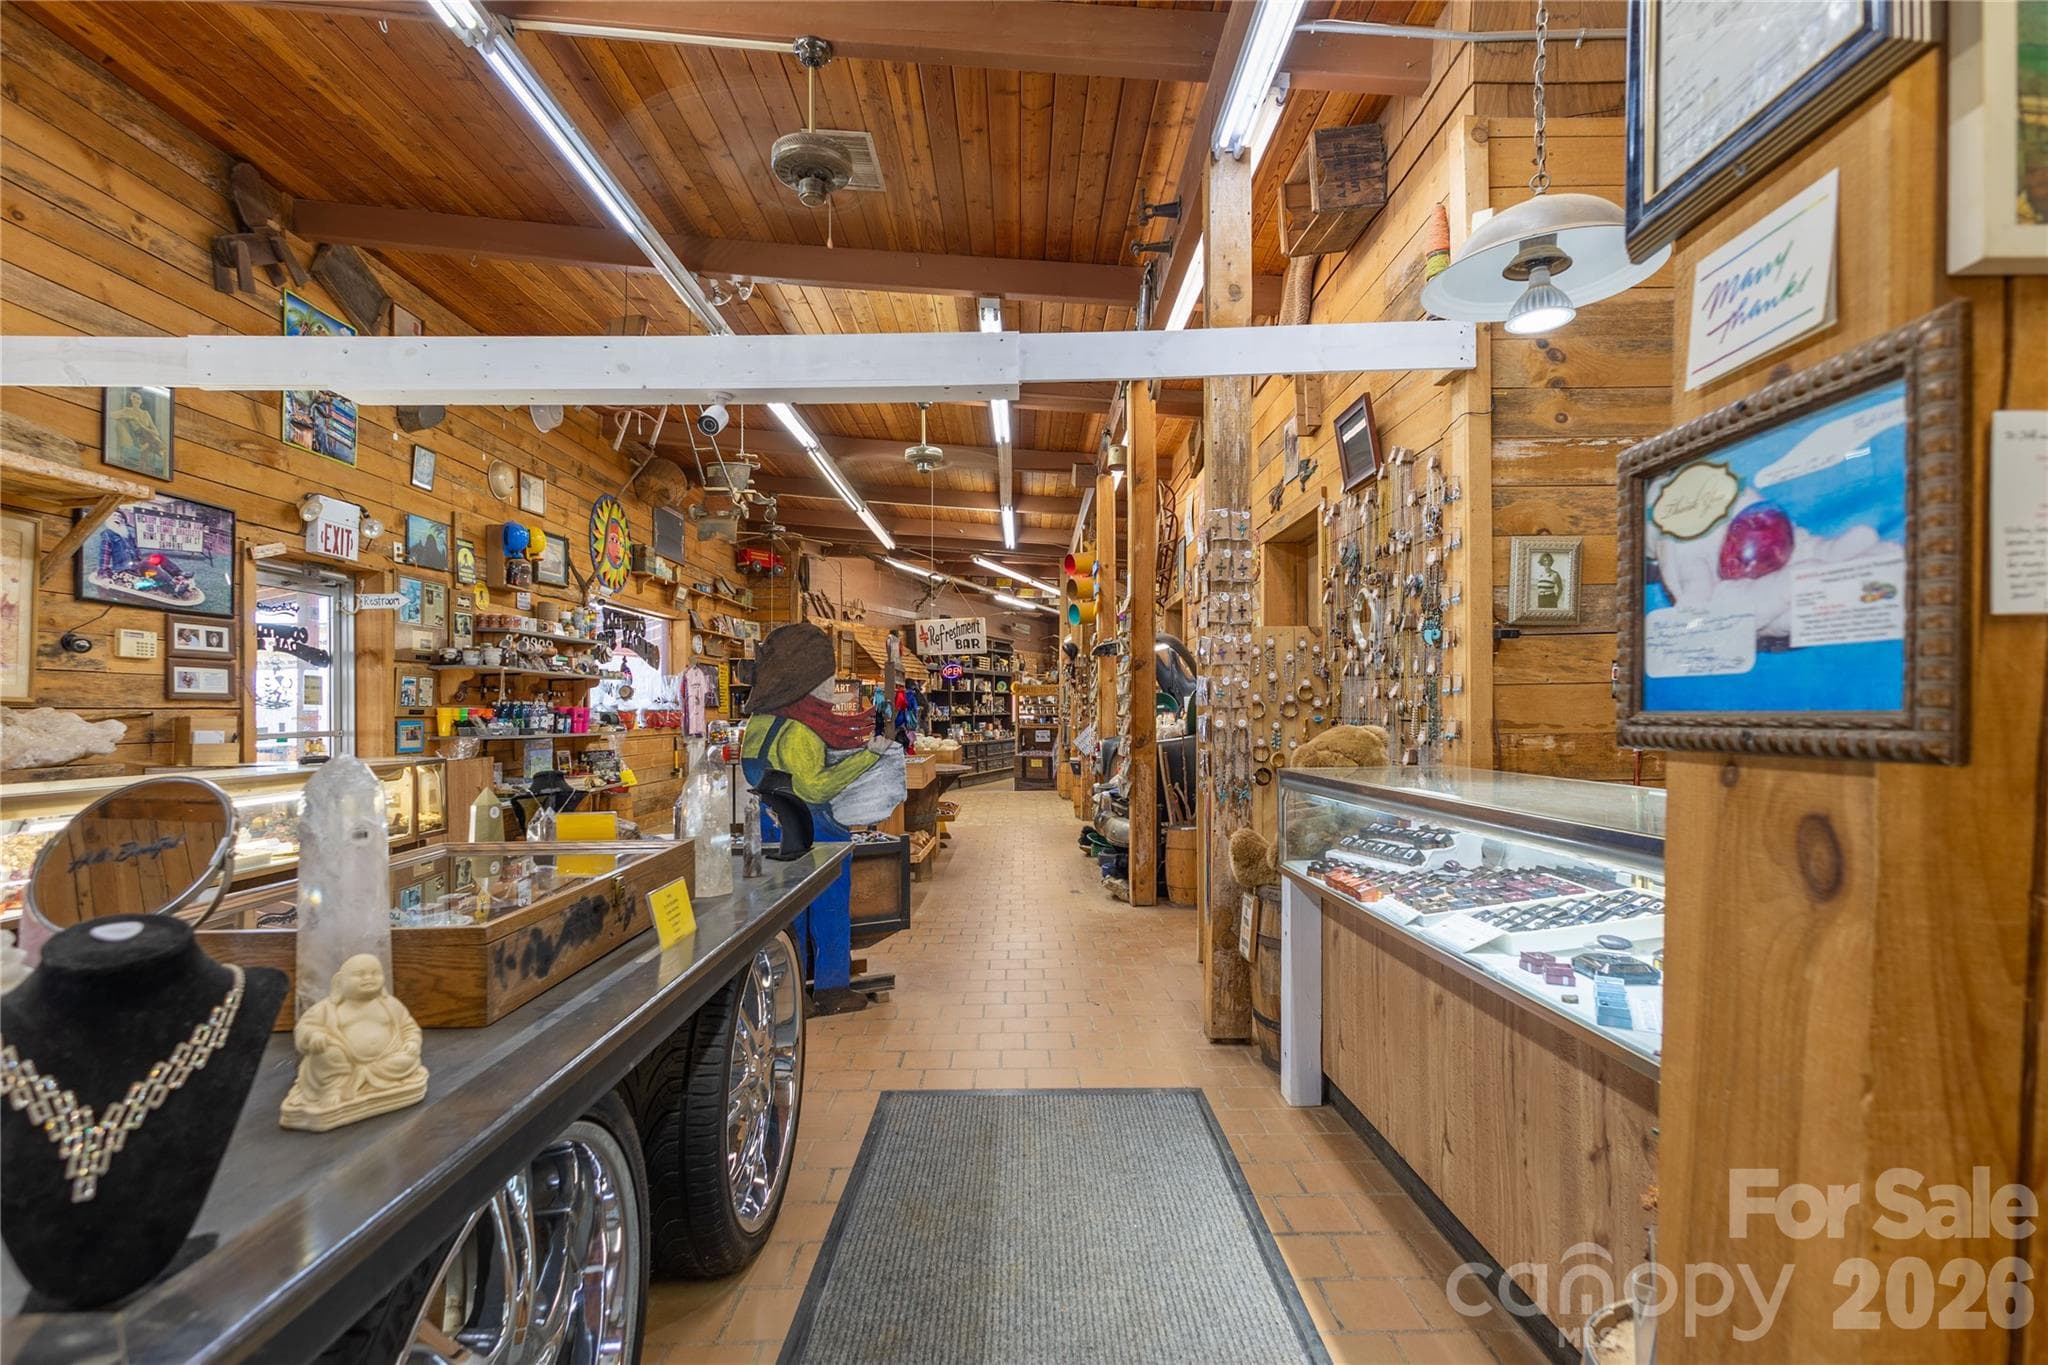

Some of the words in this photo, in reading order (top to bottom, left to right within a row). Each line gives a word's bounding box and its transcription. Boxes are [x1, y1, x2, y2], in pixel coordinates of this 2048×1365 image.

[324, 523, 352, 557] EXIT
[363, 595, 400, 606] Restroom
[928, 619, 981, 651] Refreshment
[955, 638, 980, 649] BAR
[943, 665, 963, 678] OPEN
